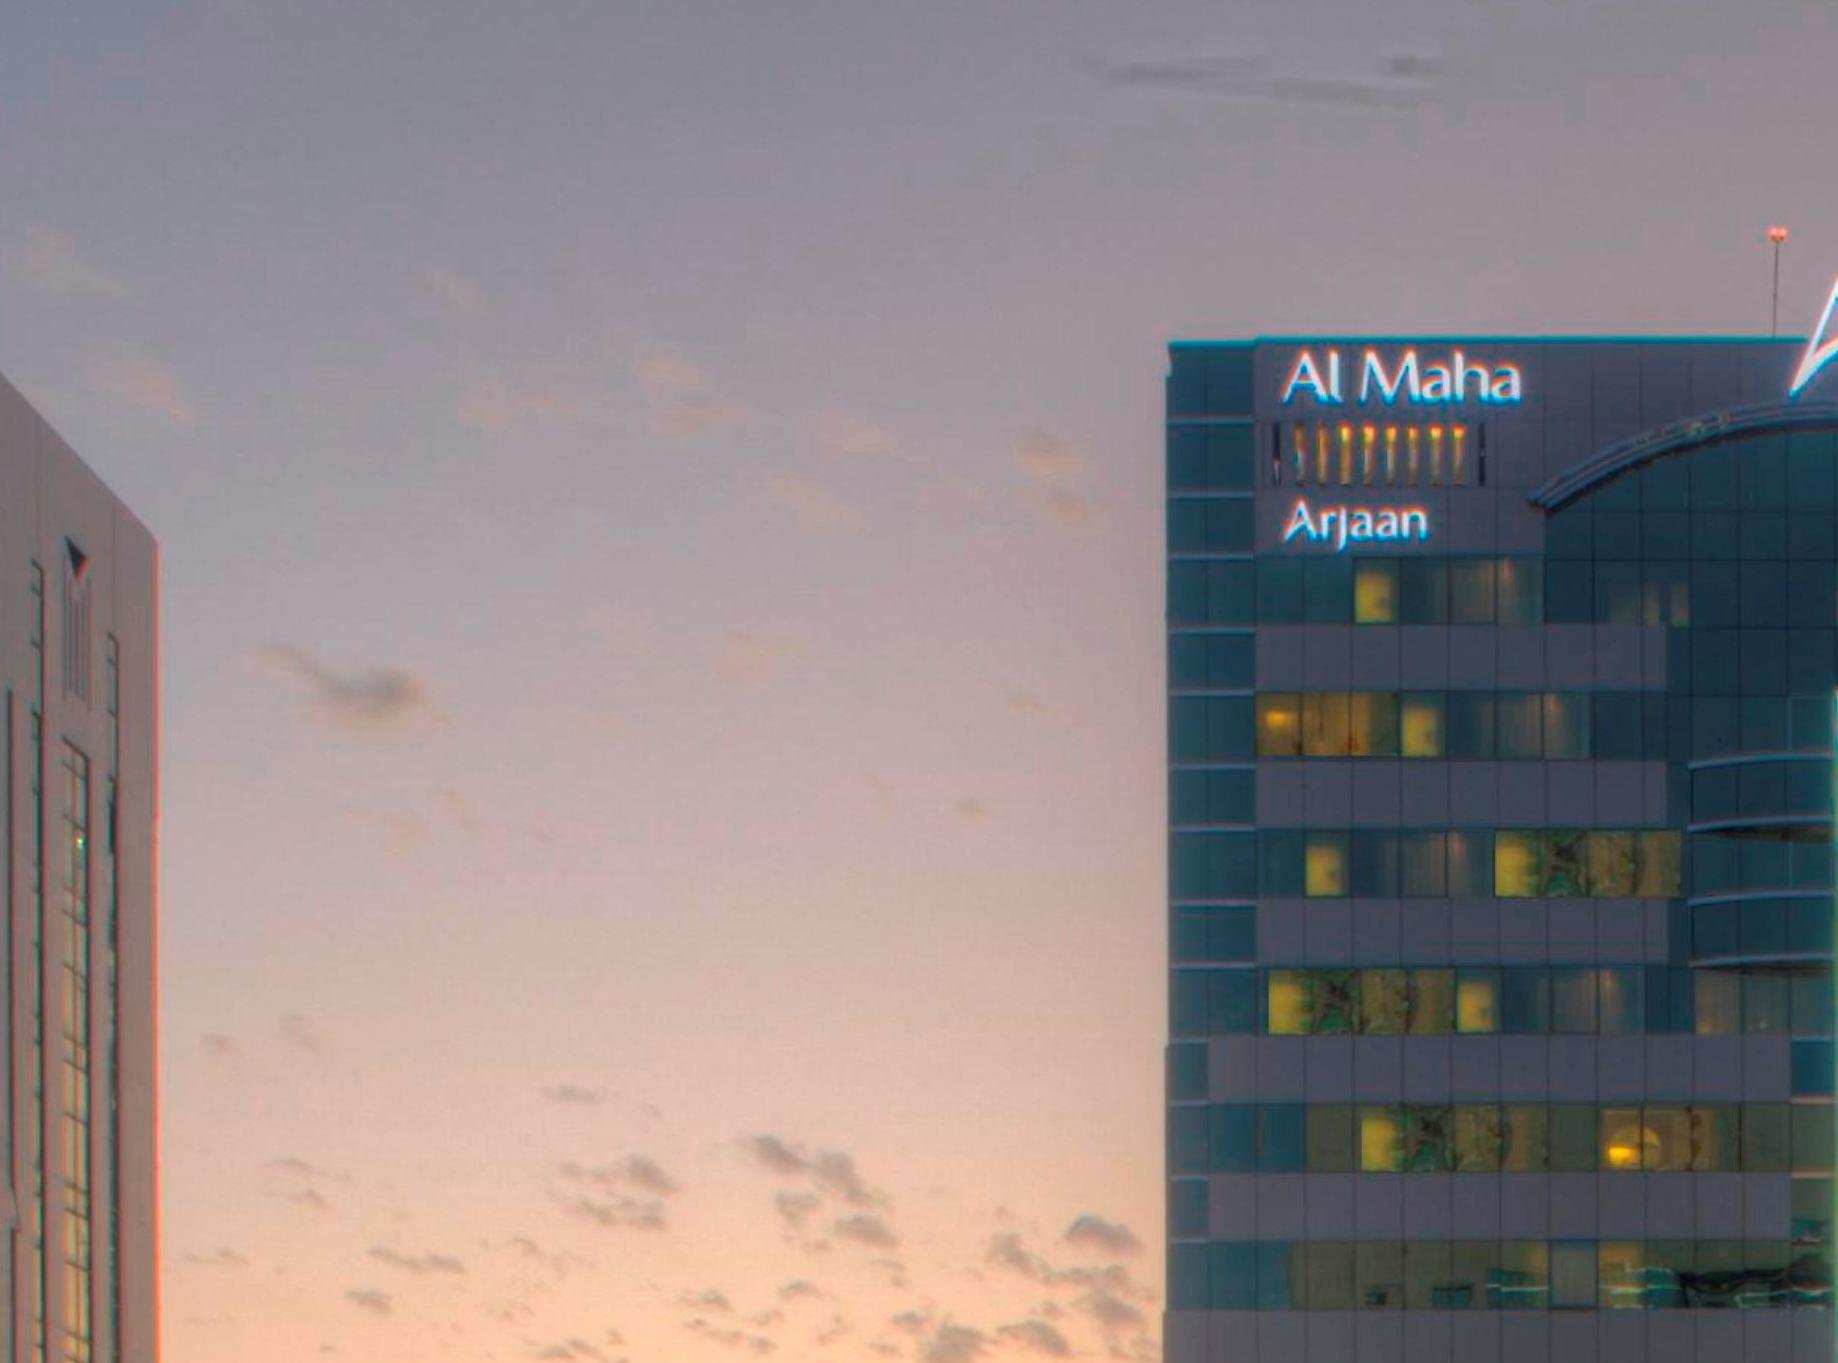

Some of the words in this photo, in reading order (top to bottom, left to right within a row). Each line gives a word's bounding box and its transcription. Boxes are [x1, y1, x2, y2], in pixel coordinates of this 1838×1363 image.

[1283, 350, 1342, 402] Al
[1360, 350, 1521, 402] Maha
[1284, 499, 1428, 551] Arjaan
